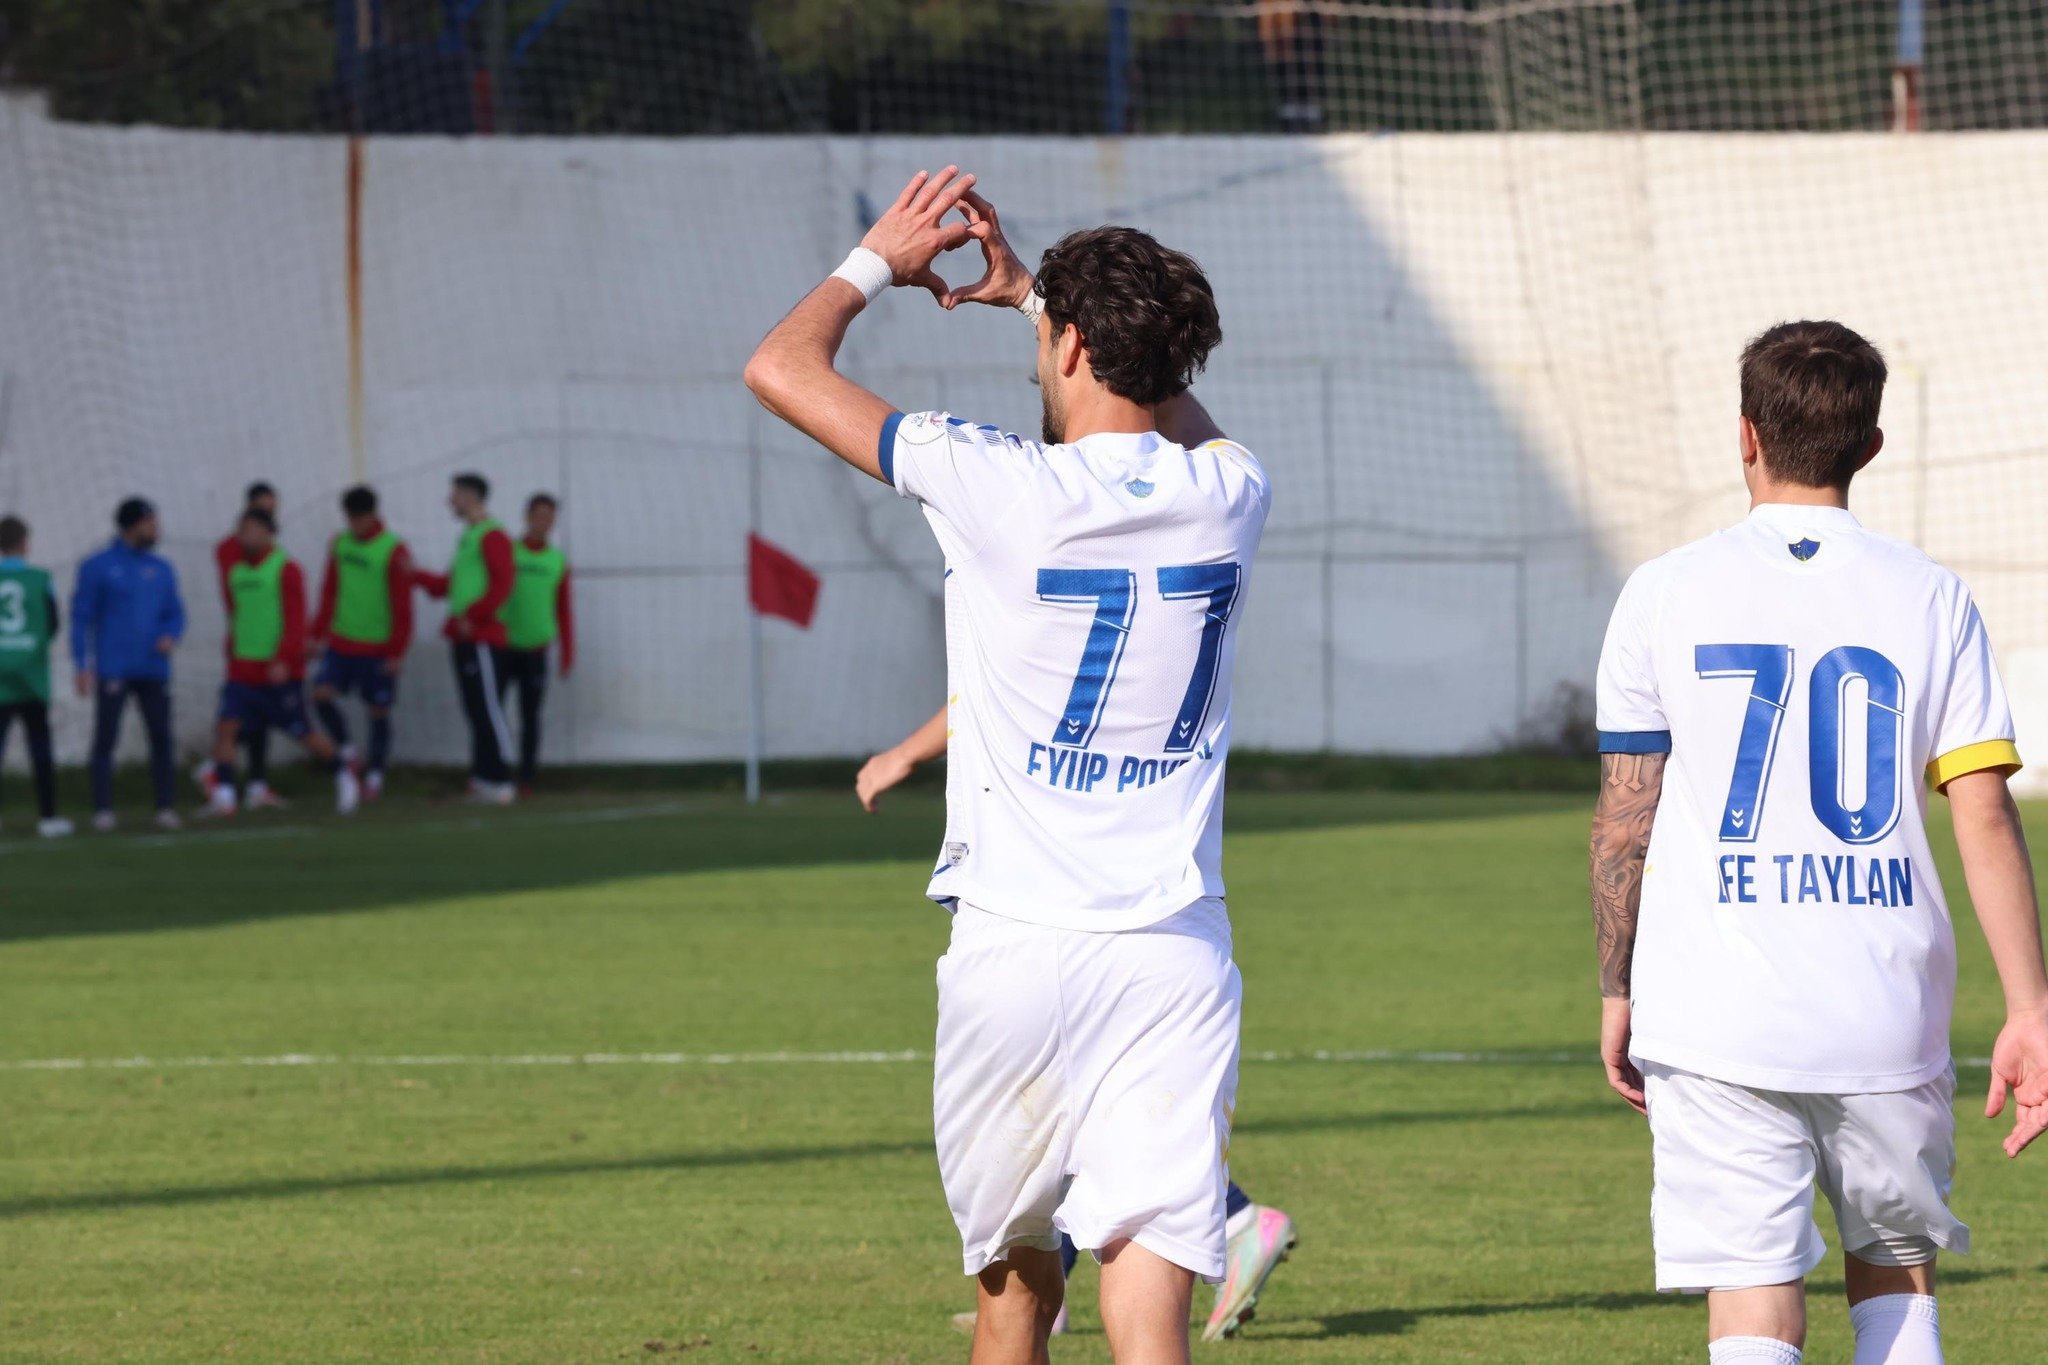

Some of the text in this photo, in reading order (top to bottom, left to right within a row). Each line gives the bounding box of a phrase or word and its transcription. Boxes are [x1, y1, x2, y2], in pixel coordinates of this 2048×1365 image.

[1036, 562, 1242, 753] 77
[1116, 740, 1214, 793] POY
[1695, 644, 1905, 845] 70
[1773, 853, 1914, 907] TAYLAN
